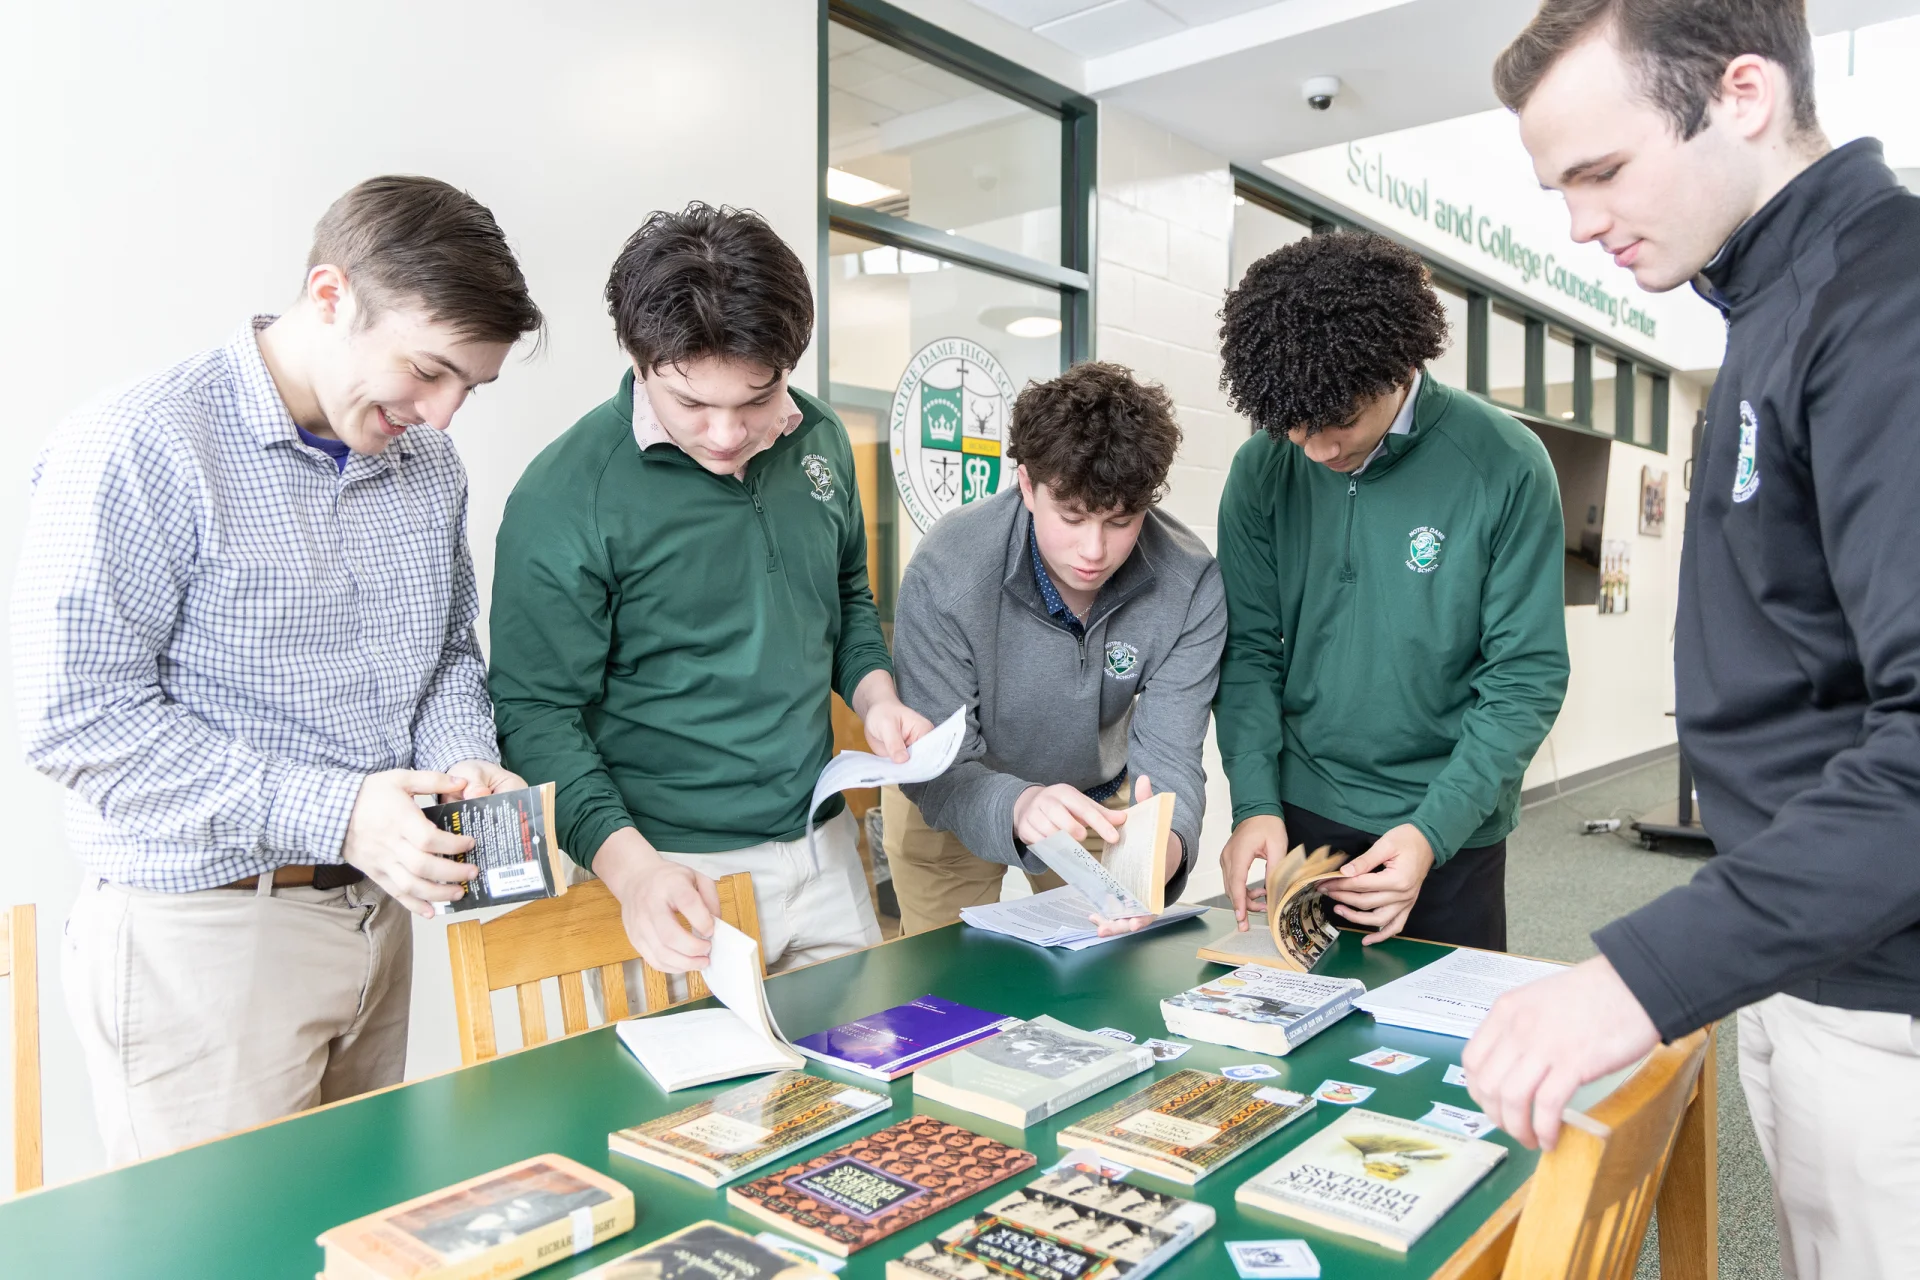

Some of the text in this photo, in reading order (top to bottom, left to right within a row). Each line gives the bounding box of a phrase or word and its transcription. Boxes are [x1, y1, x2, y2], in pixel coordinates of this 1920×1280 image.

[1348, 141, 1656, 340] School and College Counseling Center
[893, 364, 920, 433] NOTRE
[918, 341, 957, 369] DAME
[960, 342, 995, 373] HIGH
[1409, 526, 1445, 541] NOTRE DAME
[451, 811, 461, 831] WHY
[1246, 989, 1315, 1005] LOCKING
[1286, 1026, 1303, 1040] LOCKING
[1301, 1022, 1308, 1031] UP
[1307, 1018, 1316, 1027] OUR
[1314, 1014, 1323, 1023] OWN
[828, 1168, 896, 1200] FREDERICK
[838, 1164, 905, 1194] DOUGLASS
[839, 1180, 860, 1192] LIFE
[1283, 1170, 1412, 1214] FREDERICK
[1287, 1183, 1310, 1193] Life
[1300, 1164, 1420, 1204] DOUGLASS
[823, 1179, 880, 1208] NARRATIVE
[859, 1189, 880, 1200] THE
[1311, 1189, 1330, 1198] the
[1347, 1198, 1402, 1222] Narrative
[536, 1236, 572, 1259] RICHAR
[979, 1232, 1080, 1275] THE SOULS OF
[998, 1227, 1086, 1265] BLACK FOLK
